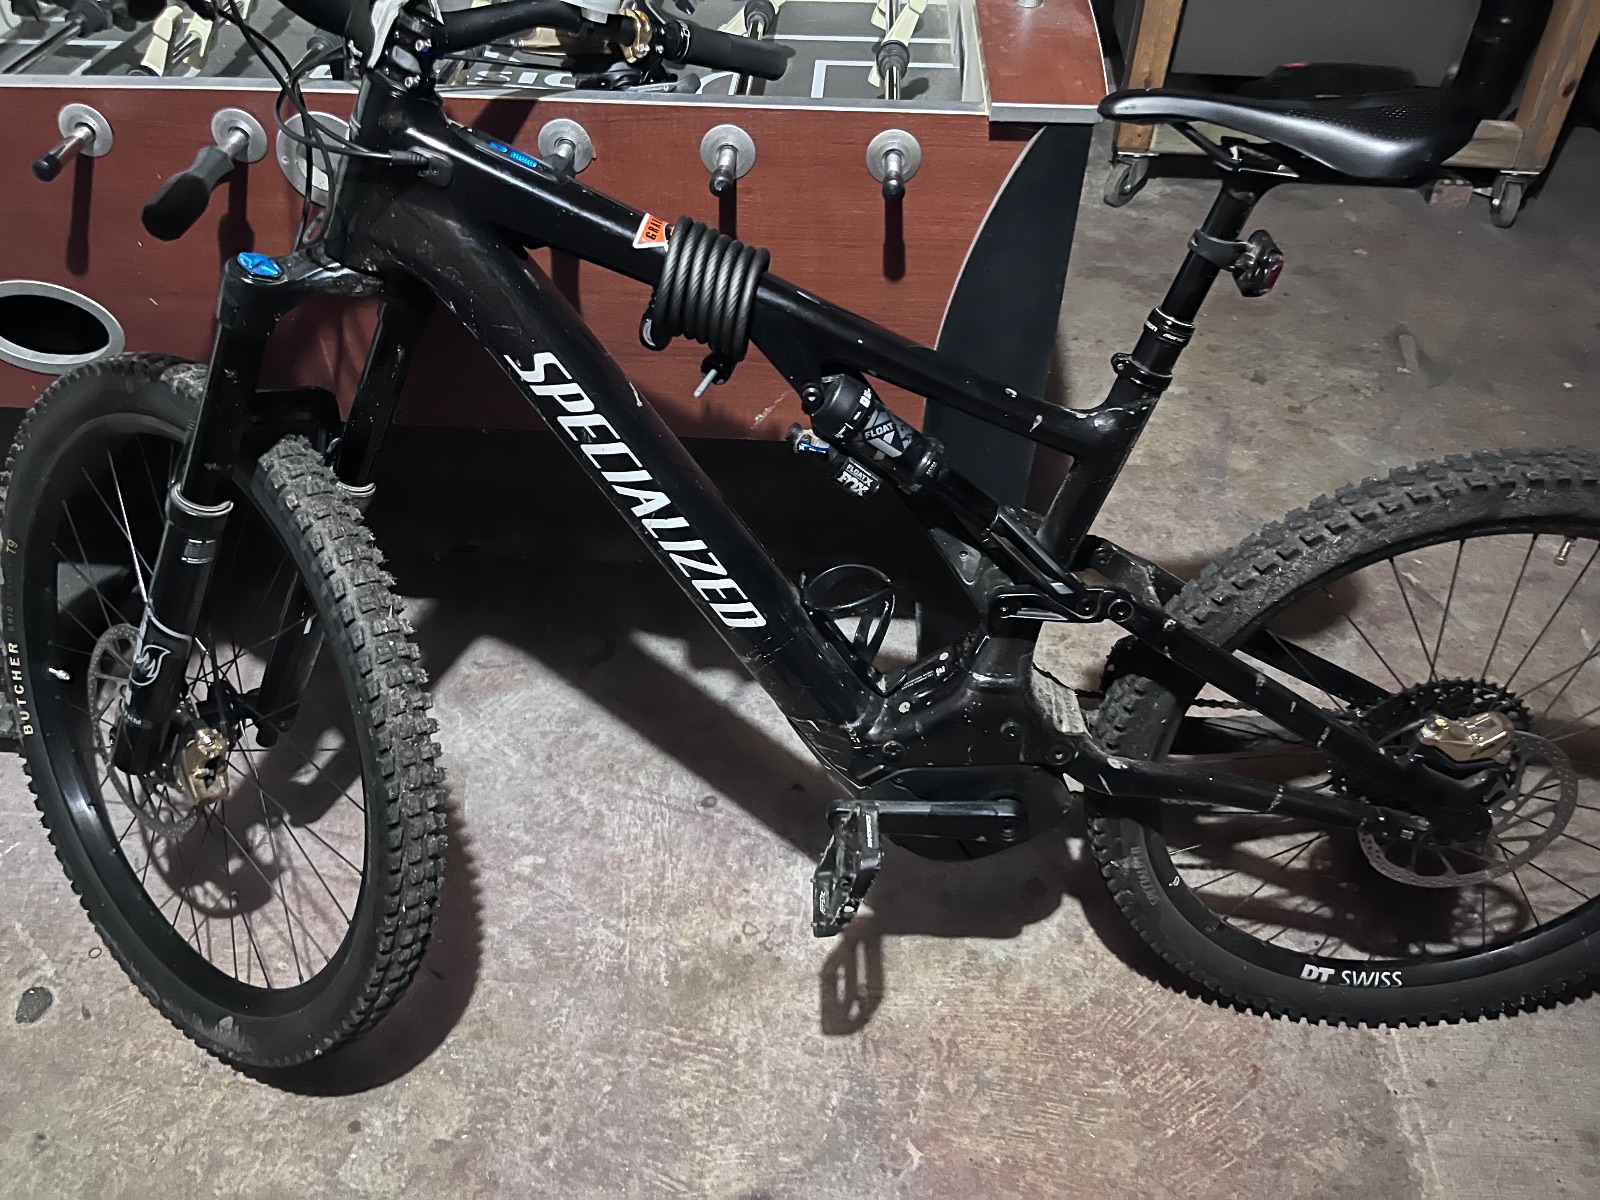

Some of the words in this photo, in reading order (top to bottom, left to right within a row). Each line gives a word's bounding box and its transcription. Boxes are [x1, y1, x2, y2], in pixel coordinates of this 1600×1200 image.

[864, 421, 895, 441] FLOAT
[503, 351, 767, 627] SPECIALIZED
[837, 471, 870, 497] FOX
[8, 642, 34, 736] BUTCHER
[1300, 963, 1336, 983] DT
[1339, 969, 1403, 988] SWISS
